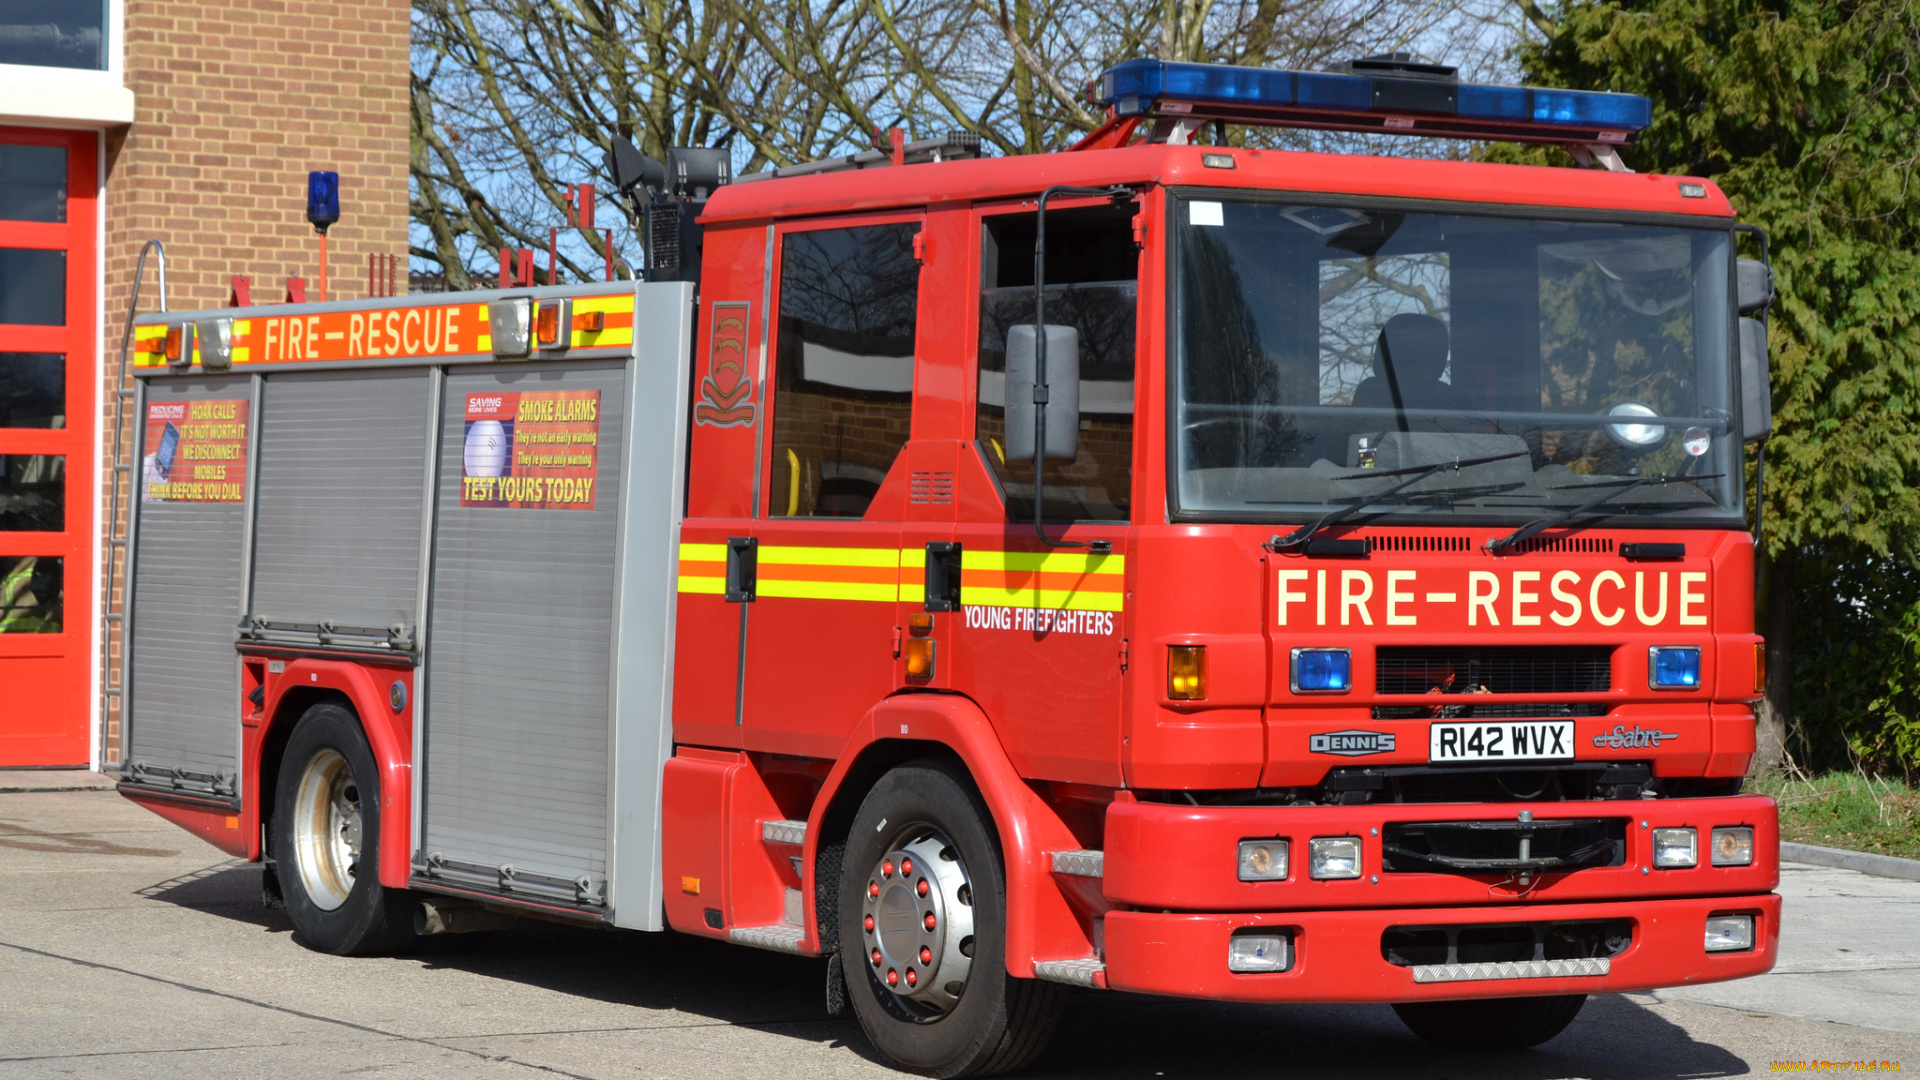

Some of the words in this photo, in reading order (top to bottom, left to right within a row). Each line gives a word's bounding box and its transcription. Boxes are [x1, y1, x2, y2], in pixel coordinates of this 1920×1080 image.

[150, 405, 185, 414] REDUCING
[469, 398, 502, 407] SAVING
[518, 400, 554, 422] SMOKE
[554, 399, 597, 422] ALARMS
[192, 405, 213, 420] HOAX
[213, 404, 236, 419] CALLS
[180, 425, 194, 439] IT'S
[194, 424, 209, 440] NOT
[210, 424, 237, 439] WORTH
[237, 424, 246, 439] IT
[516, 429, 537, 446] They're
[537, 431, 548, 443] not
[548, 433, 556, 443] an
[557, 429, 572, 446] early
[572, 430, 597, 446] warning
[183, 445, 194, 460] WE
[194, 444, 241, 460] DISCONNECT
[518, 451, 539, 467] They're
[539, 455, 553, 468] your
[553, 452, 567, 467] only
[568, 451, 592, 467] warning
[194, 465, 226, 480] MOBILES
[147, 482, 171, 499] THINK
[172, 483, 203, 500] BEFORE
[203, 483, 221, 500] YOU
[222, 483, 242, 500] DIAL
[464, 477, 496, 501] TEST
[498, 477, 543, 502] YOURS
[545, 478, 593, 503] TODAY
[964, 605, 1011, 630] YOUNG
[1015, 608, 1114, 636] FIREFIGHTERS
[1310, 734, 1395, 751] DENNIS
[1440, 727, 1504, 757] R142
[1511, 726, 1565, 755] WVX
[1610, 725, 1662, 748] Sabre
